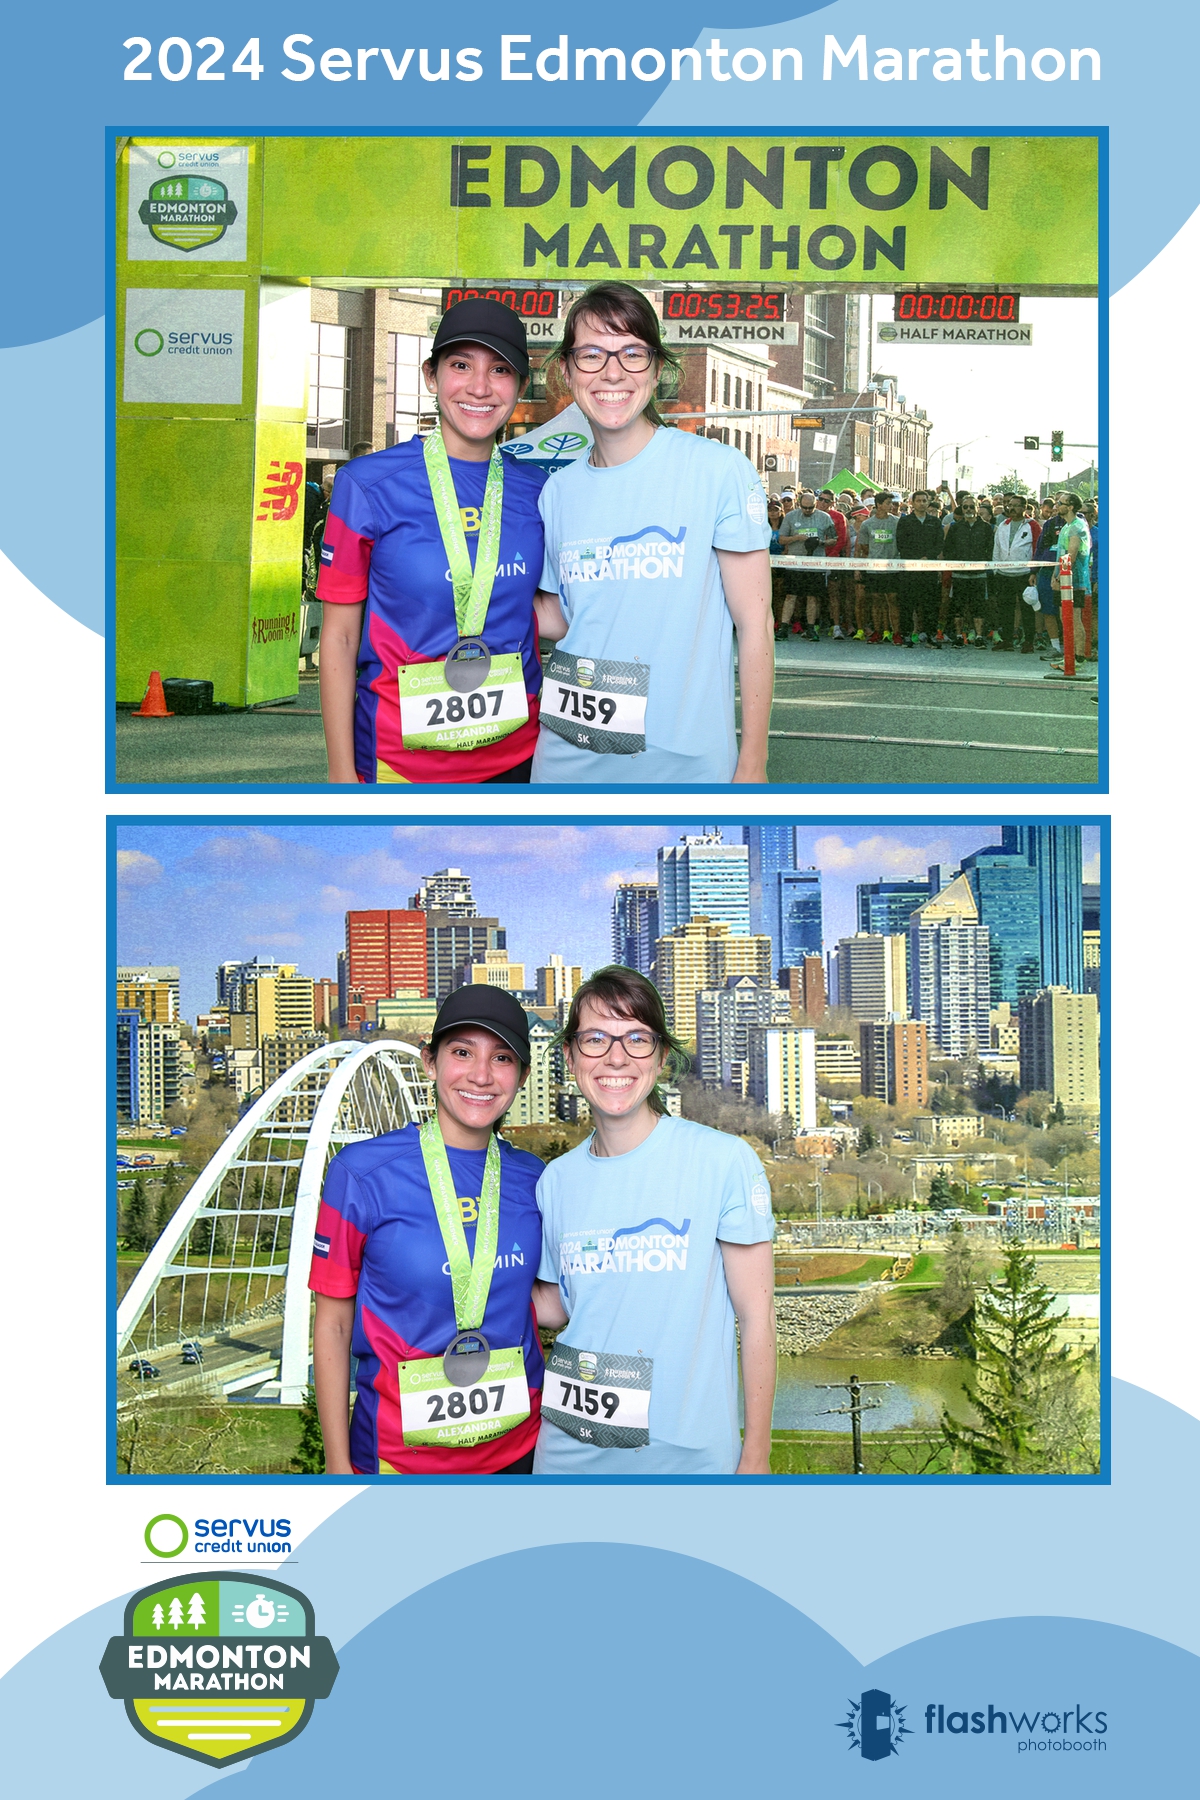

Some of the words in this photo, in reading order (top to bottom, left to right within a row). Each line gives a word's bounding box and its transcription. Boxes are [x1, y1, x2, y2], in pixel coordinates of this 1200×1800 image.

[178, 152, 219, 160] servus
[450, 145, 990, 211] EDMONTON
[149, 203, 226, 213] EDMONTON
[160, 214, 215, 222] MARATHON
[524, 223, 906, 270] MARATHON
[168, 332, 233, 344] servus
[679, 325, 784, 340] MARATHON
[900, 328, 938, 339] HALF
[943, 329, 1030, 341] MARATHON
[168, 345, 200, 354] credit
[203, 347, 233, 355] union
[596, 542, 685, 559] EDMONTON
[257, 613, 290, 636] Running
[426, 690, 504, 726] 2807
[558, 687, 617, 725] 7159
[436, 724, 500, 742] ALEXANDRA
[577, 733, 590, 744] 5K
[457, 740, 474, 748] HALF
[598, 1234, 689, 1251] EDMONTON
[427, 1385, 505, 1423] 2807
[560, 1381, 620, 1419] 7159
[437, 1420, 501, 1439] ALEXANDRA
[580, 1427, 593, 1438] 5K
[458, 1437, 475, 1445] HALF
